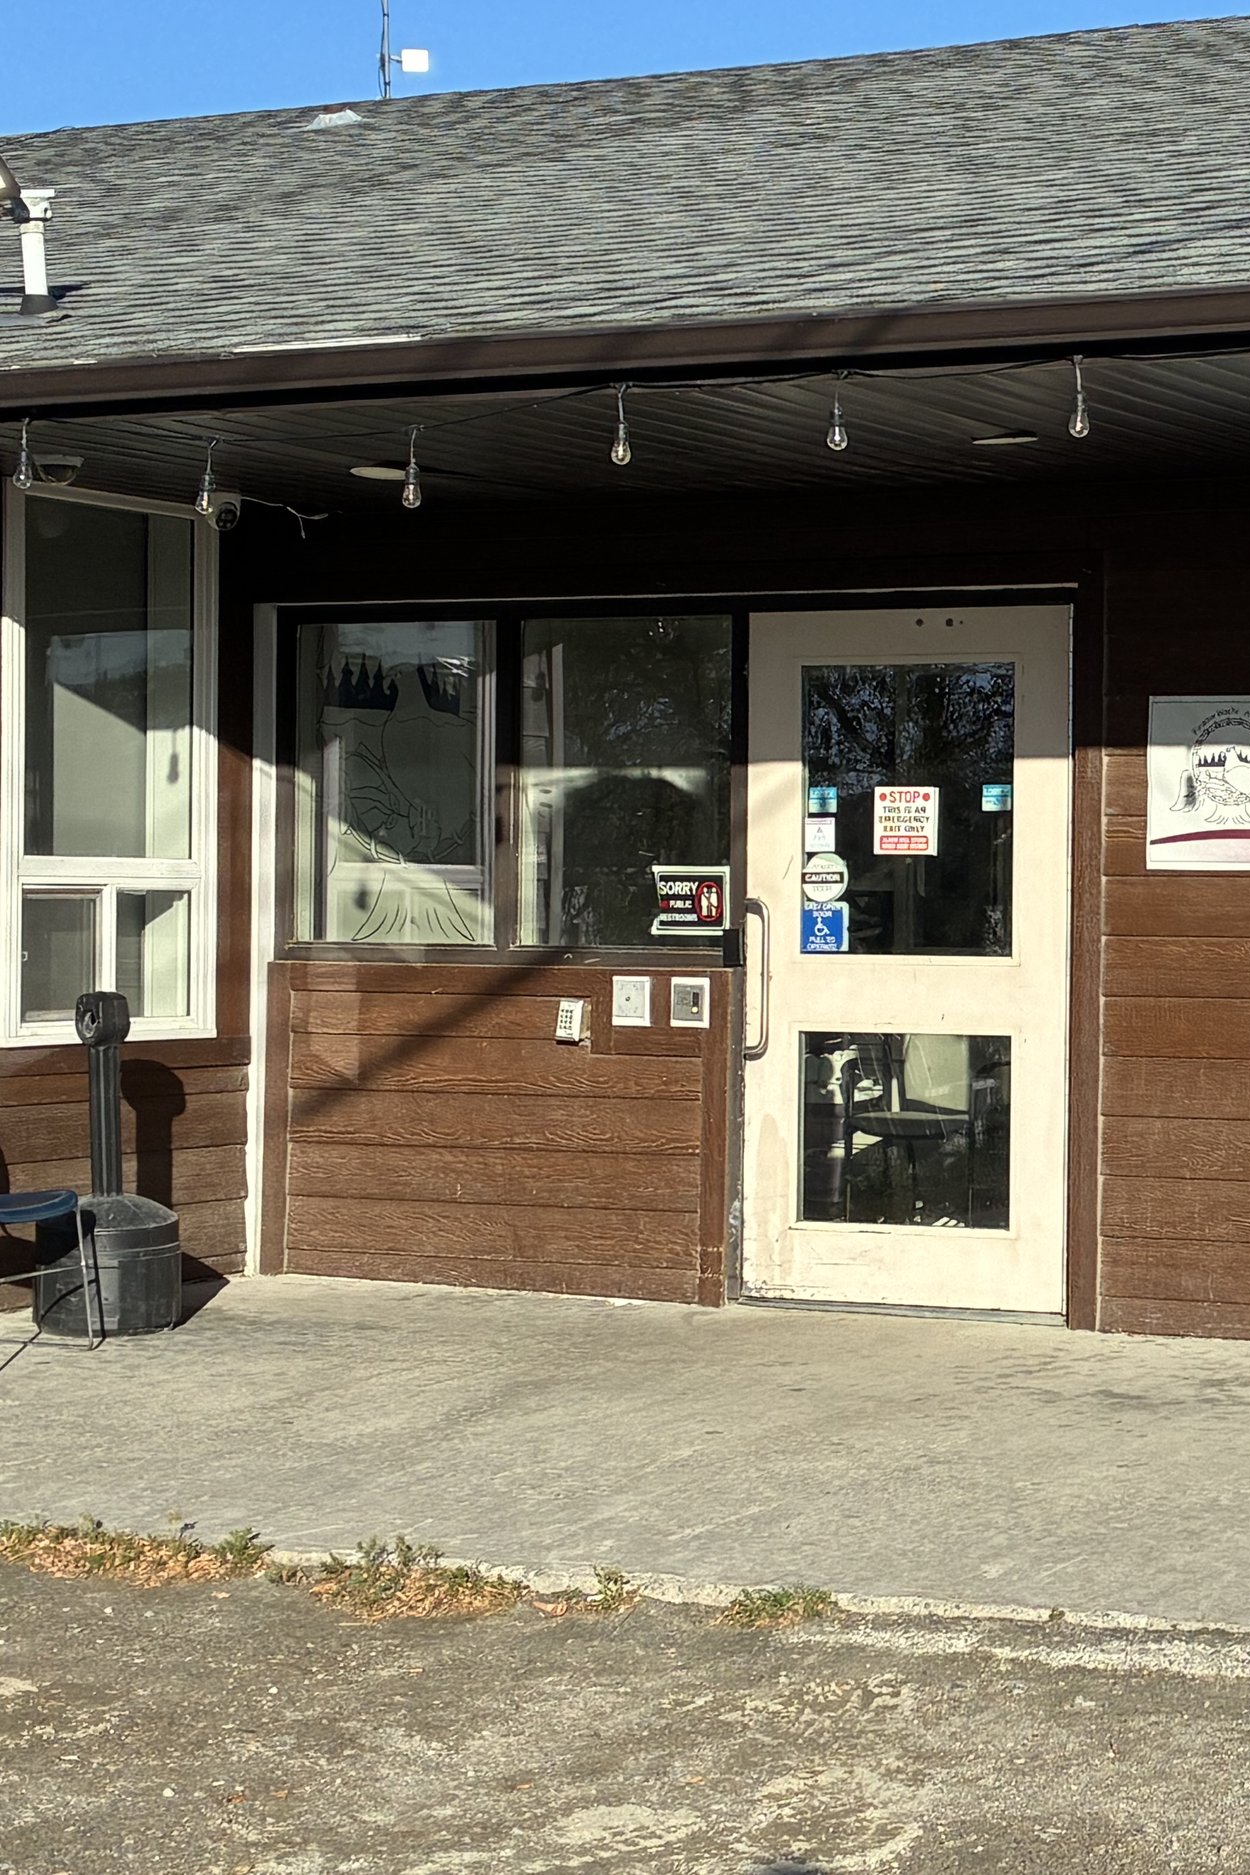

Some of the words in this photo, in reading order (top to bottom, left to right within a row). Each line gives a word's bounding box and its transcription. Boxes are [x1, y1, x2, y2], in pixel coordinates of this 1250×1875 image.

[889, 791, 921, 803] STOP
[805, 873, 841, 882] CAUTION
[659, 881, 699, 895] SORRY
[670, 900, 693, 908] PUBLIC
